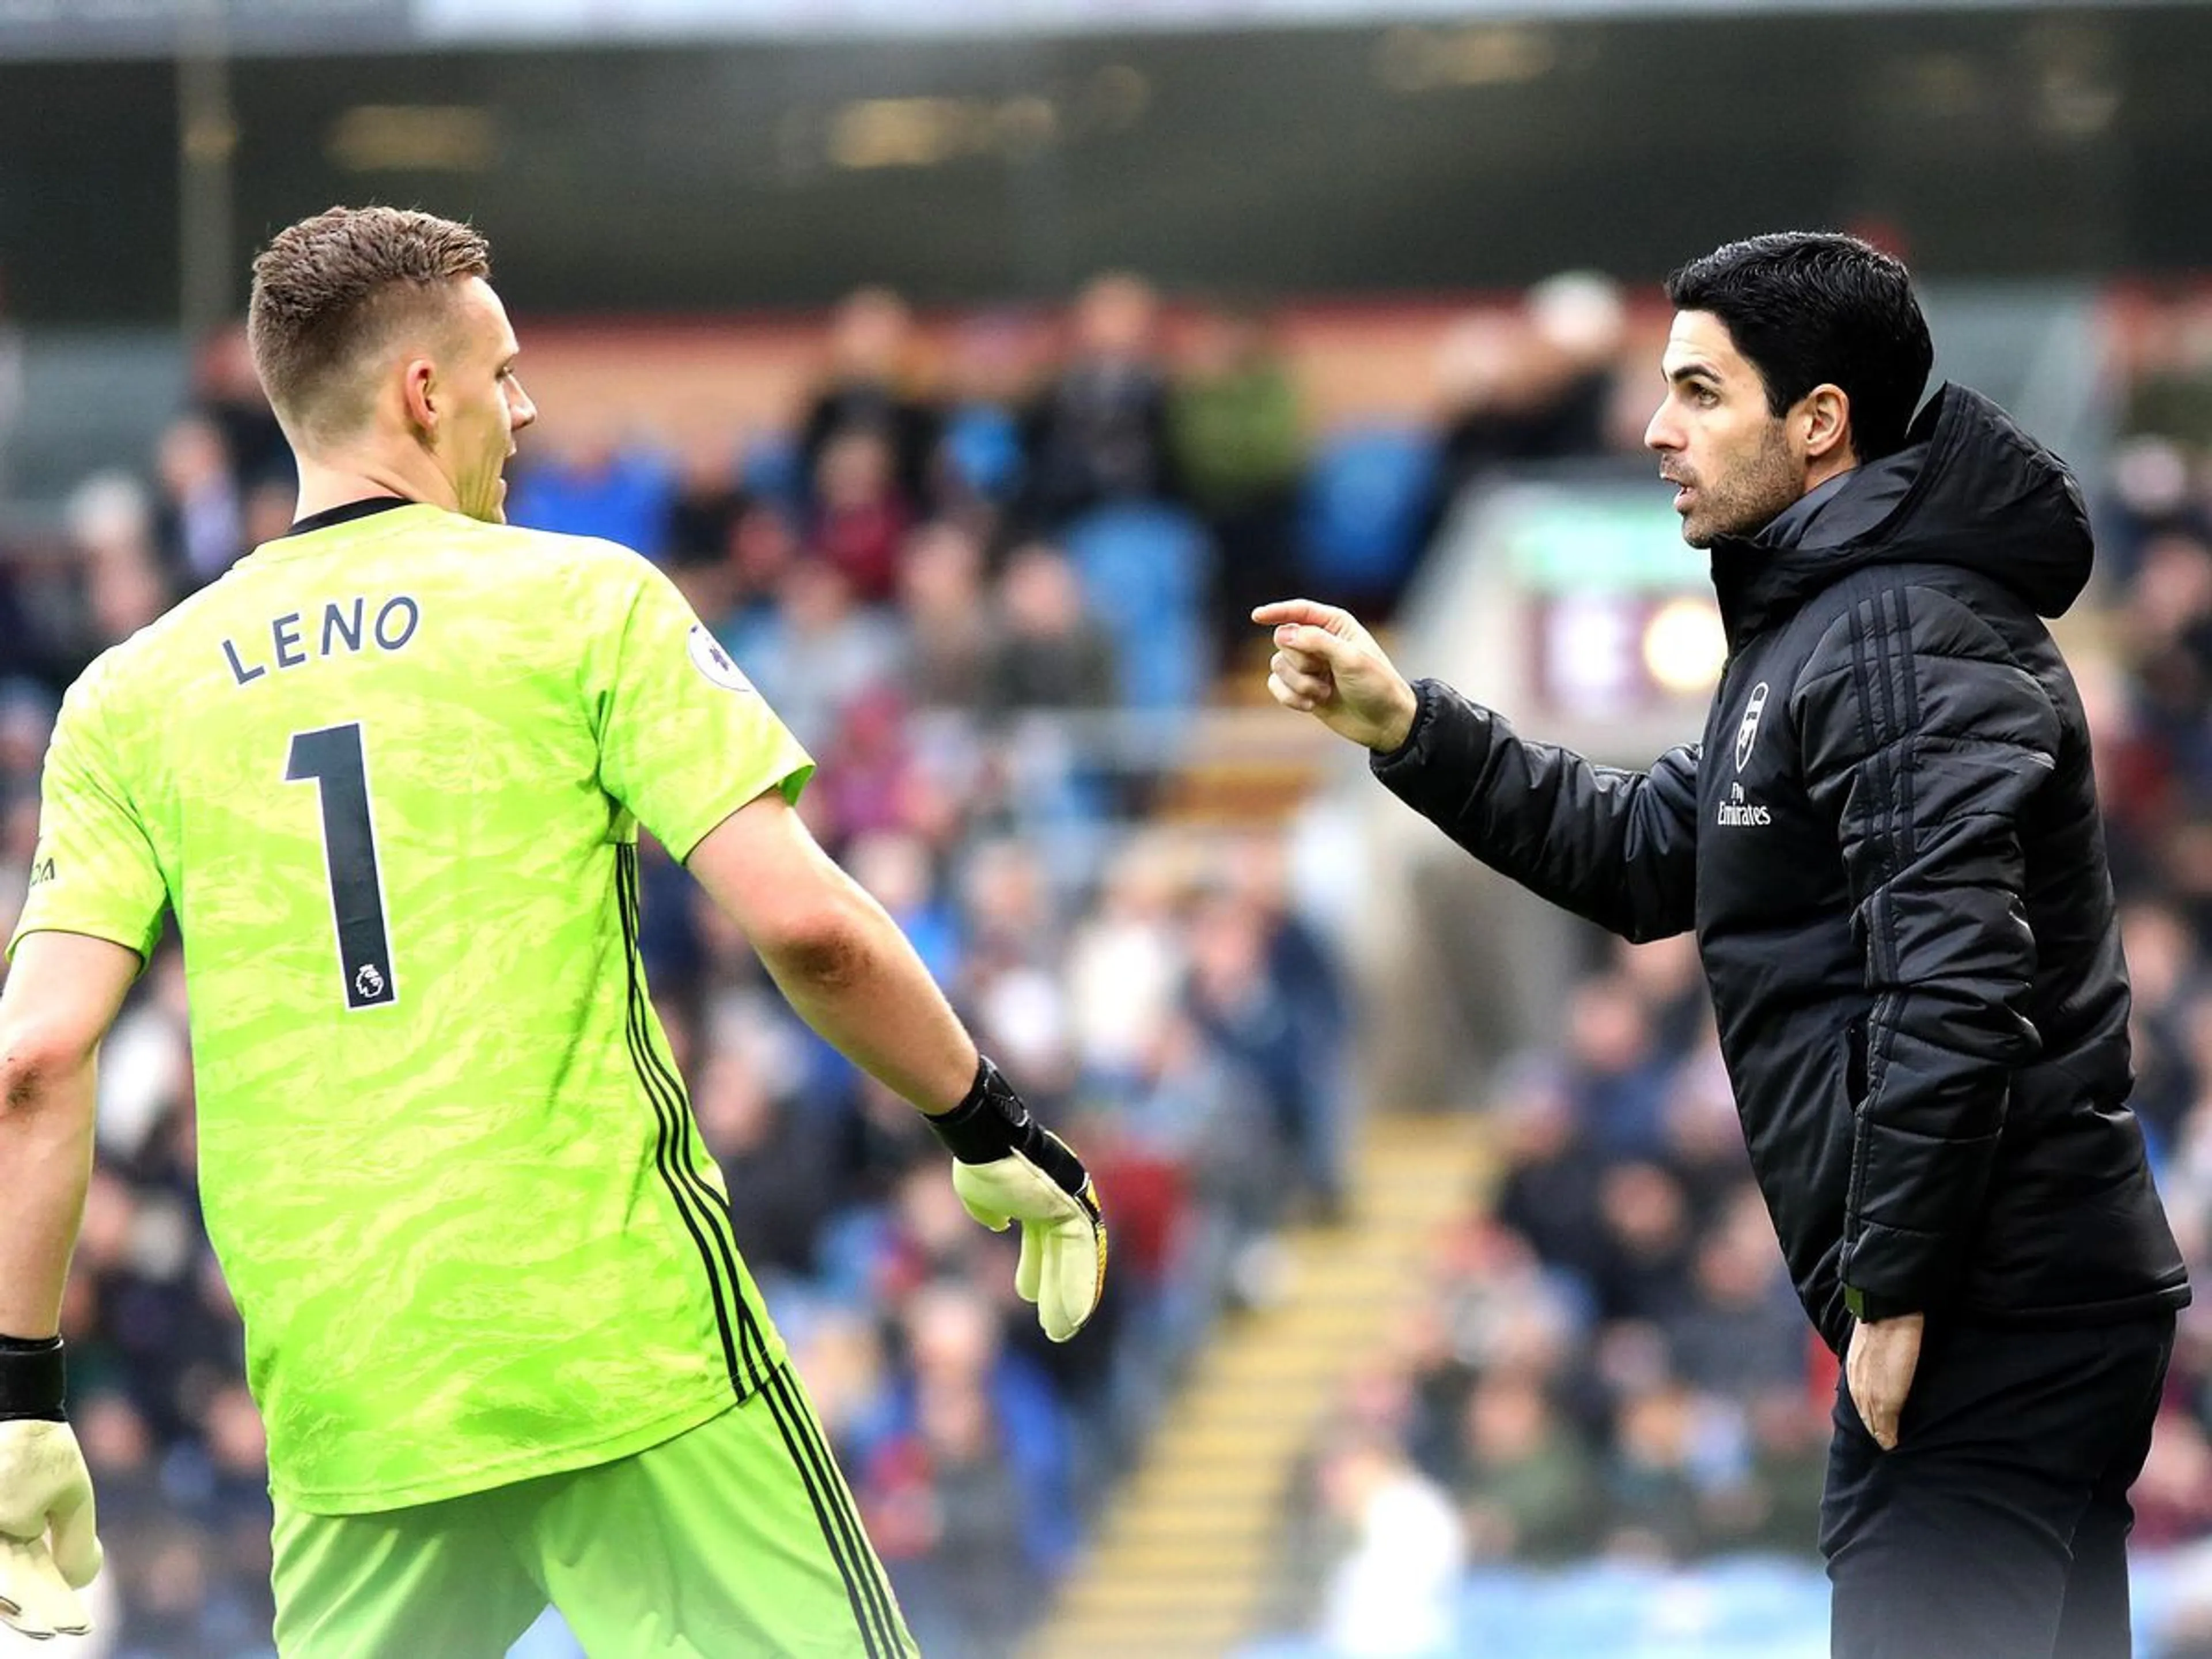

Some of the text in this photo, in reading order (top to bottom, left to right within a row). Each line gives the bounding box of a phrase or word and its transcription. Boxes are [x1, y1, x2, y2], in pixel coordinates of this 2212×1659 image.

[222, 596, 419, 685] LENO
[1718, 800, 1771, 826] Emirates
[285, 722, 396, 1009] 1
